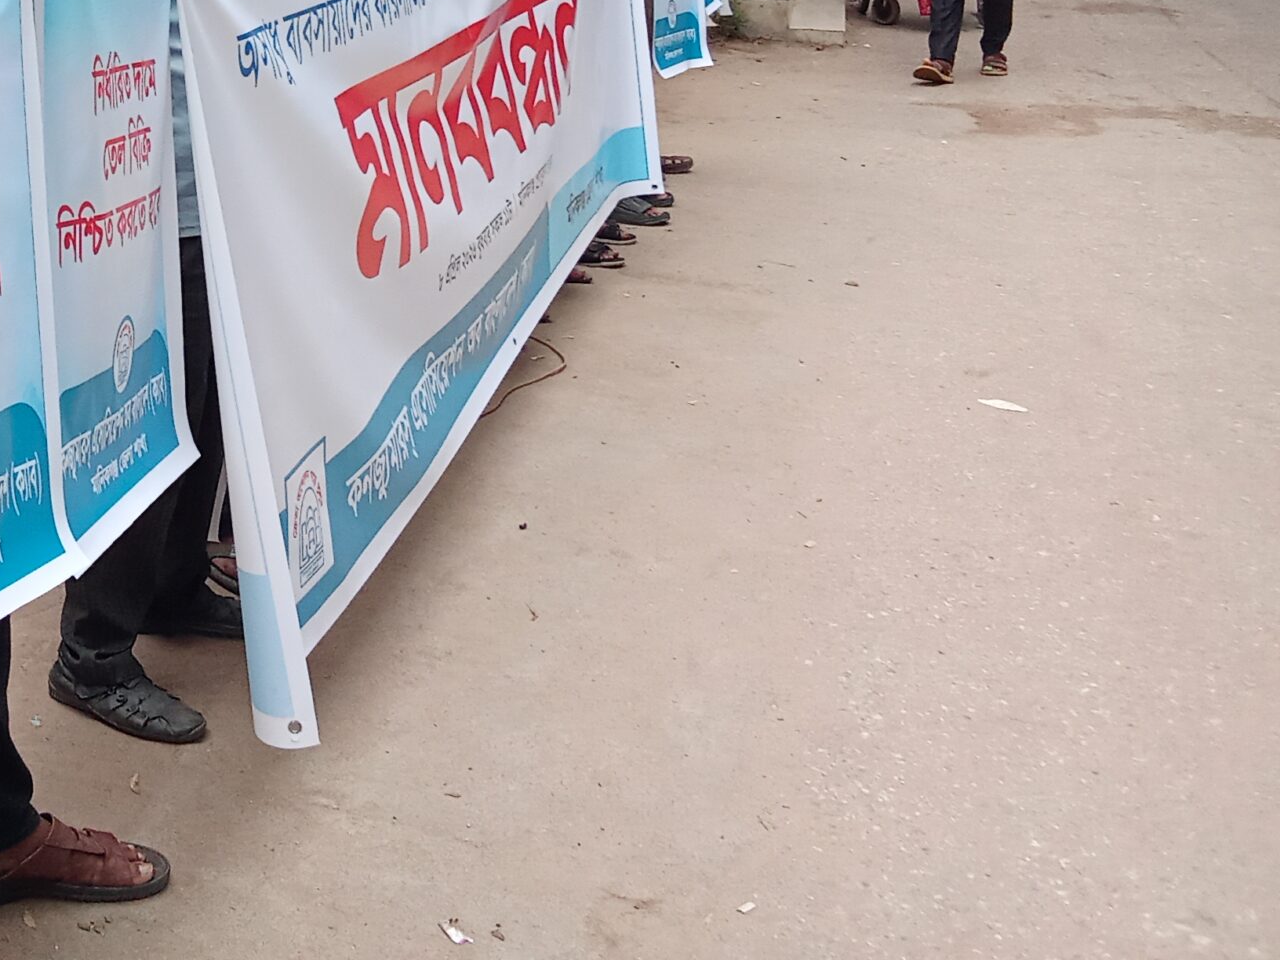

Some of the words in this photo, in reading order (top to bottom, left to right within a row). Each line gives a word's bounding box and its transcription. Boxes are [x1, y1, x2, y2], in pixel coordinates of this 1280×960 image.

[91, 51, 131, 117] নির্ধারিত
[132, 58, 157, 102] দামে
[103, 135, 126, 181] তেল
[128, 114, 152, 175] বিক্রি
[56, 200, 114, 269] নিশ্চিত
[116, 196, 147, 248] করতে
